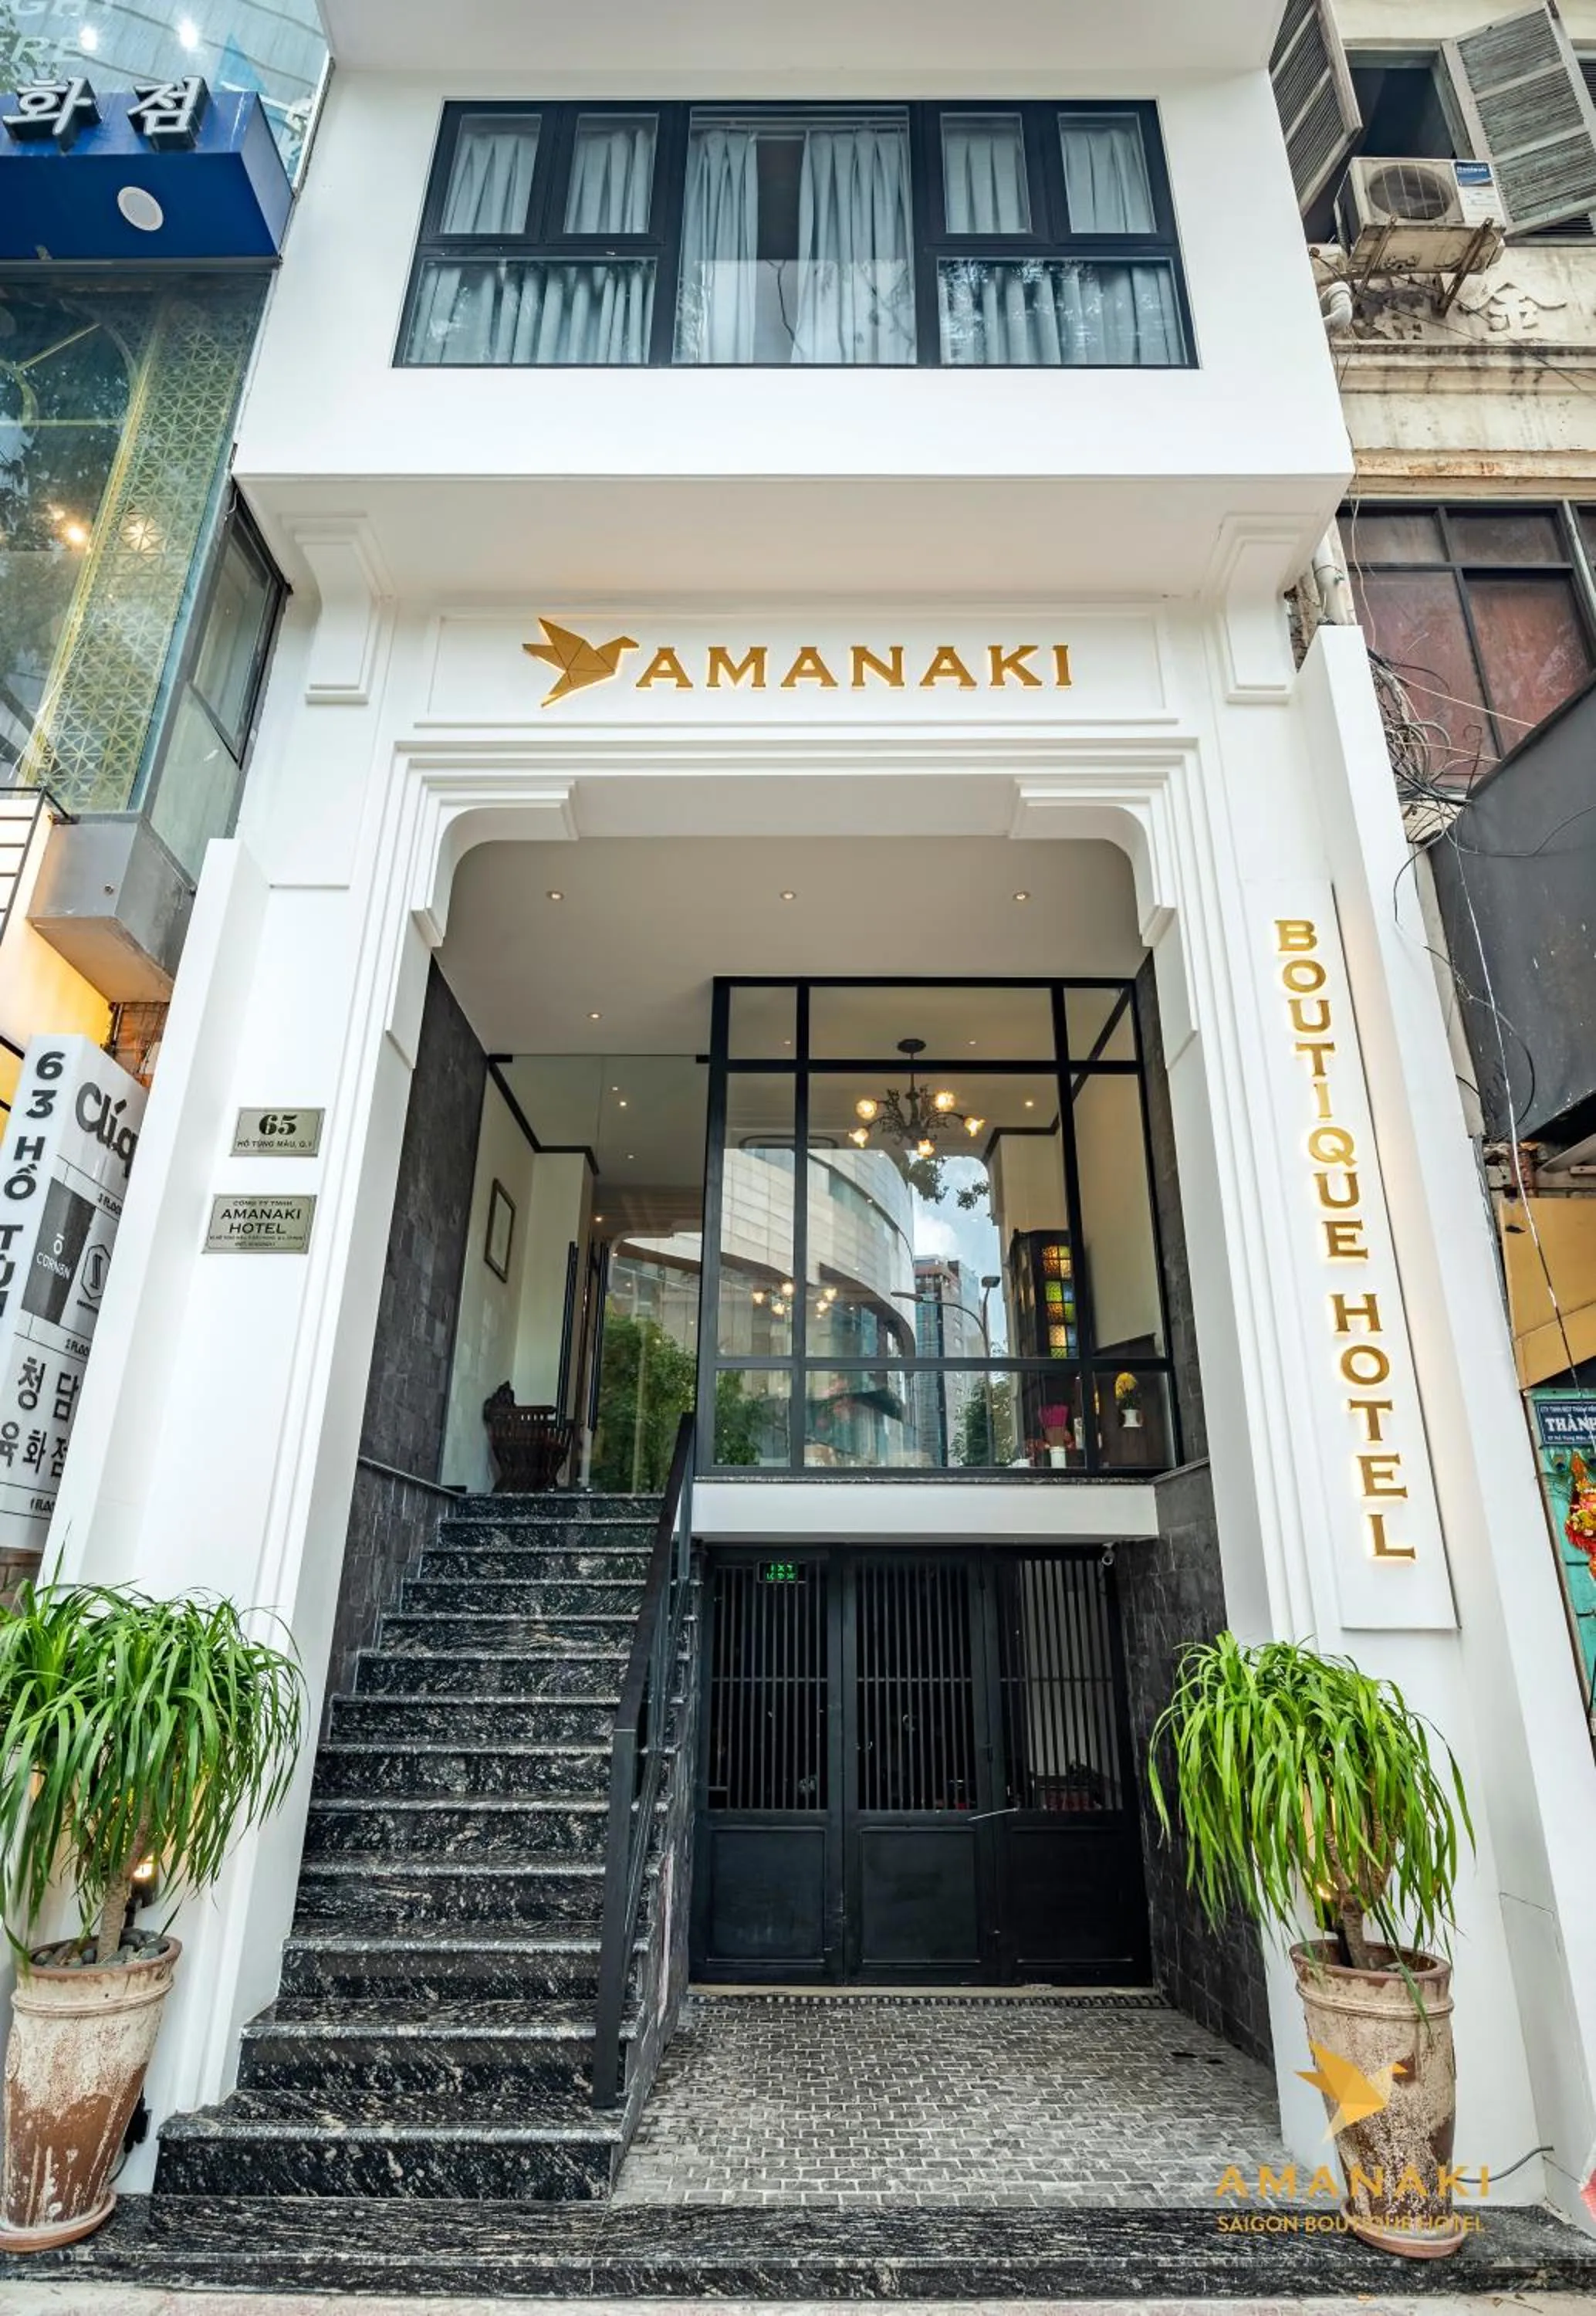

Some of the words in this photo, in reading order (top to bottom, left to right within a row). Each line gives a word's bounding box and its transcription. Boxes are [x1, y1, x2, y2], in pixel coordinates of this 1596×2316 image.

[635, 644, 1073, 689] AMANAKI
[25, 1051, 66, 1119] 63
[259, 1114, 297, 1136] 65
[221, 1208, 302, 1220] AMANAKI
[228, 1222, 286, 1234] HOTEL
[1276, 919, 1369, 1260] BOUTIQUE
[1330, 1292, 1416, 1559] HOTEL
